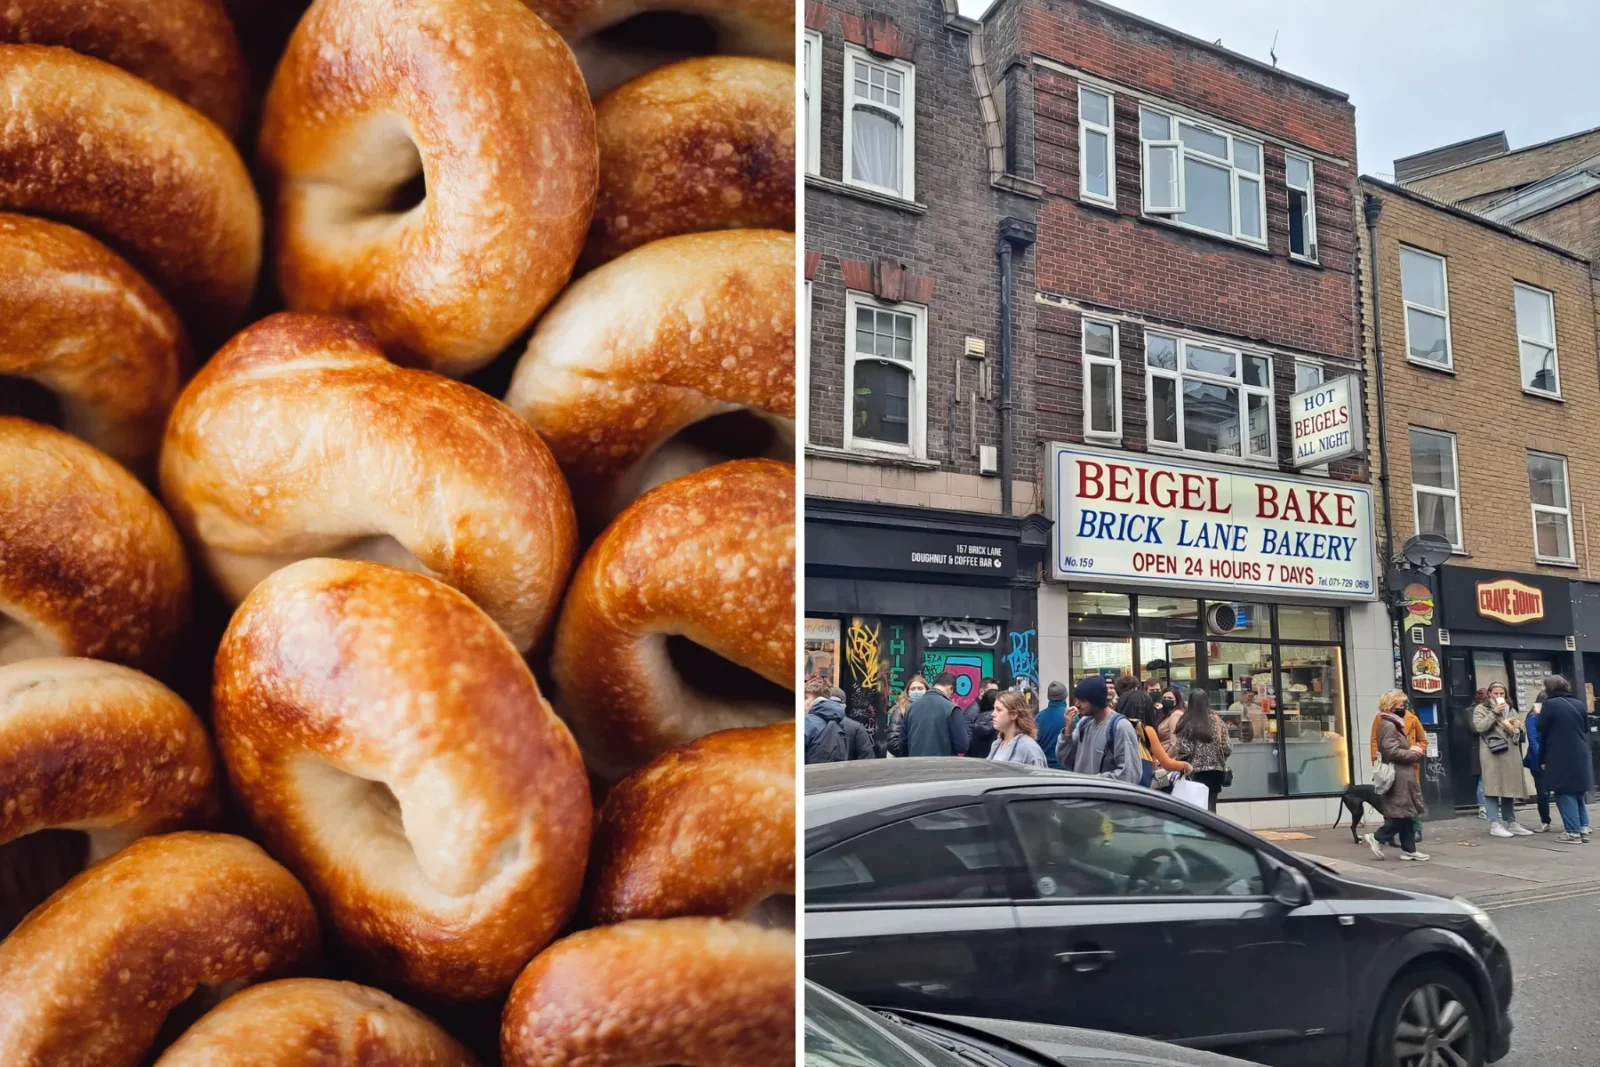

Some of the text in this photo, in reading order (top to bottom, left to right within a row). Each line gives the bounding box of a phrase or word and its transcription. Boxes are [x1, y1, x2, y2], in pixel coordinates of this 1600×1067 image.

[1304, 388, 1336, 412] HOT
[1294, 405, 1349, 439] BEIGELS
[1297, 430, 1349, 459] ALL NIGHT
[1075, 459, 1357, 528] BEIGEL BAKE
[1076, 509, 1358, 562] BRICK LANE BAKERY
[911, 552, 993, 568] DOUGHNUT & COFFEE BAR
[956, 544, 1002, 557] 157 BRICK LANE
[1132, 552, 1315, 585] OPEN 24 HOURS 7 DAYS
[1480, 587, 1540, 616] CRAVE JOINT
